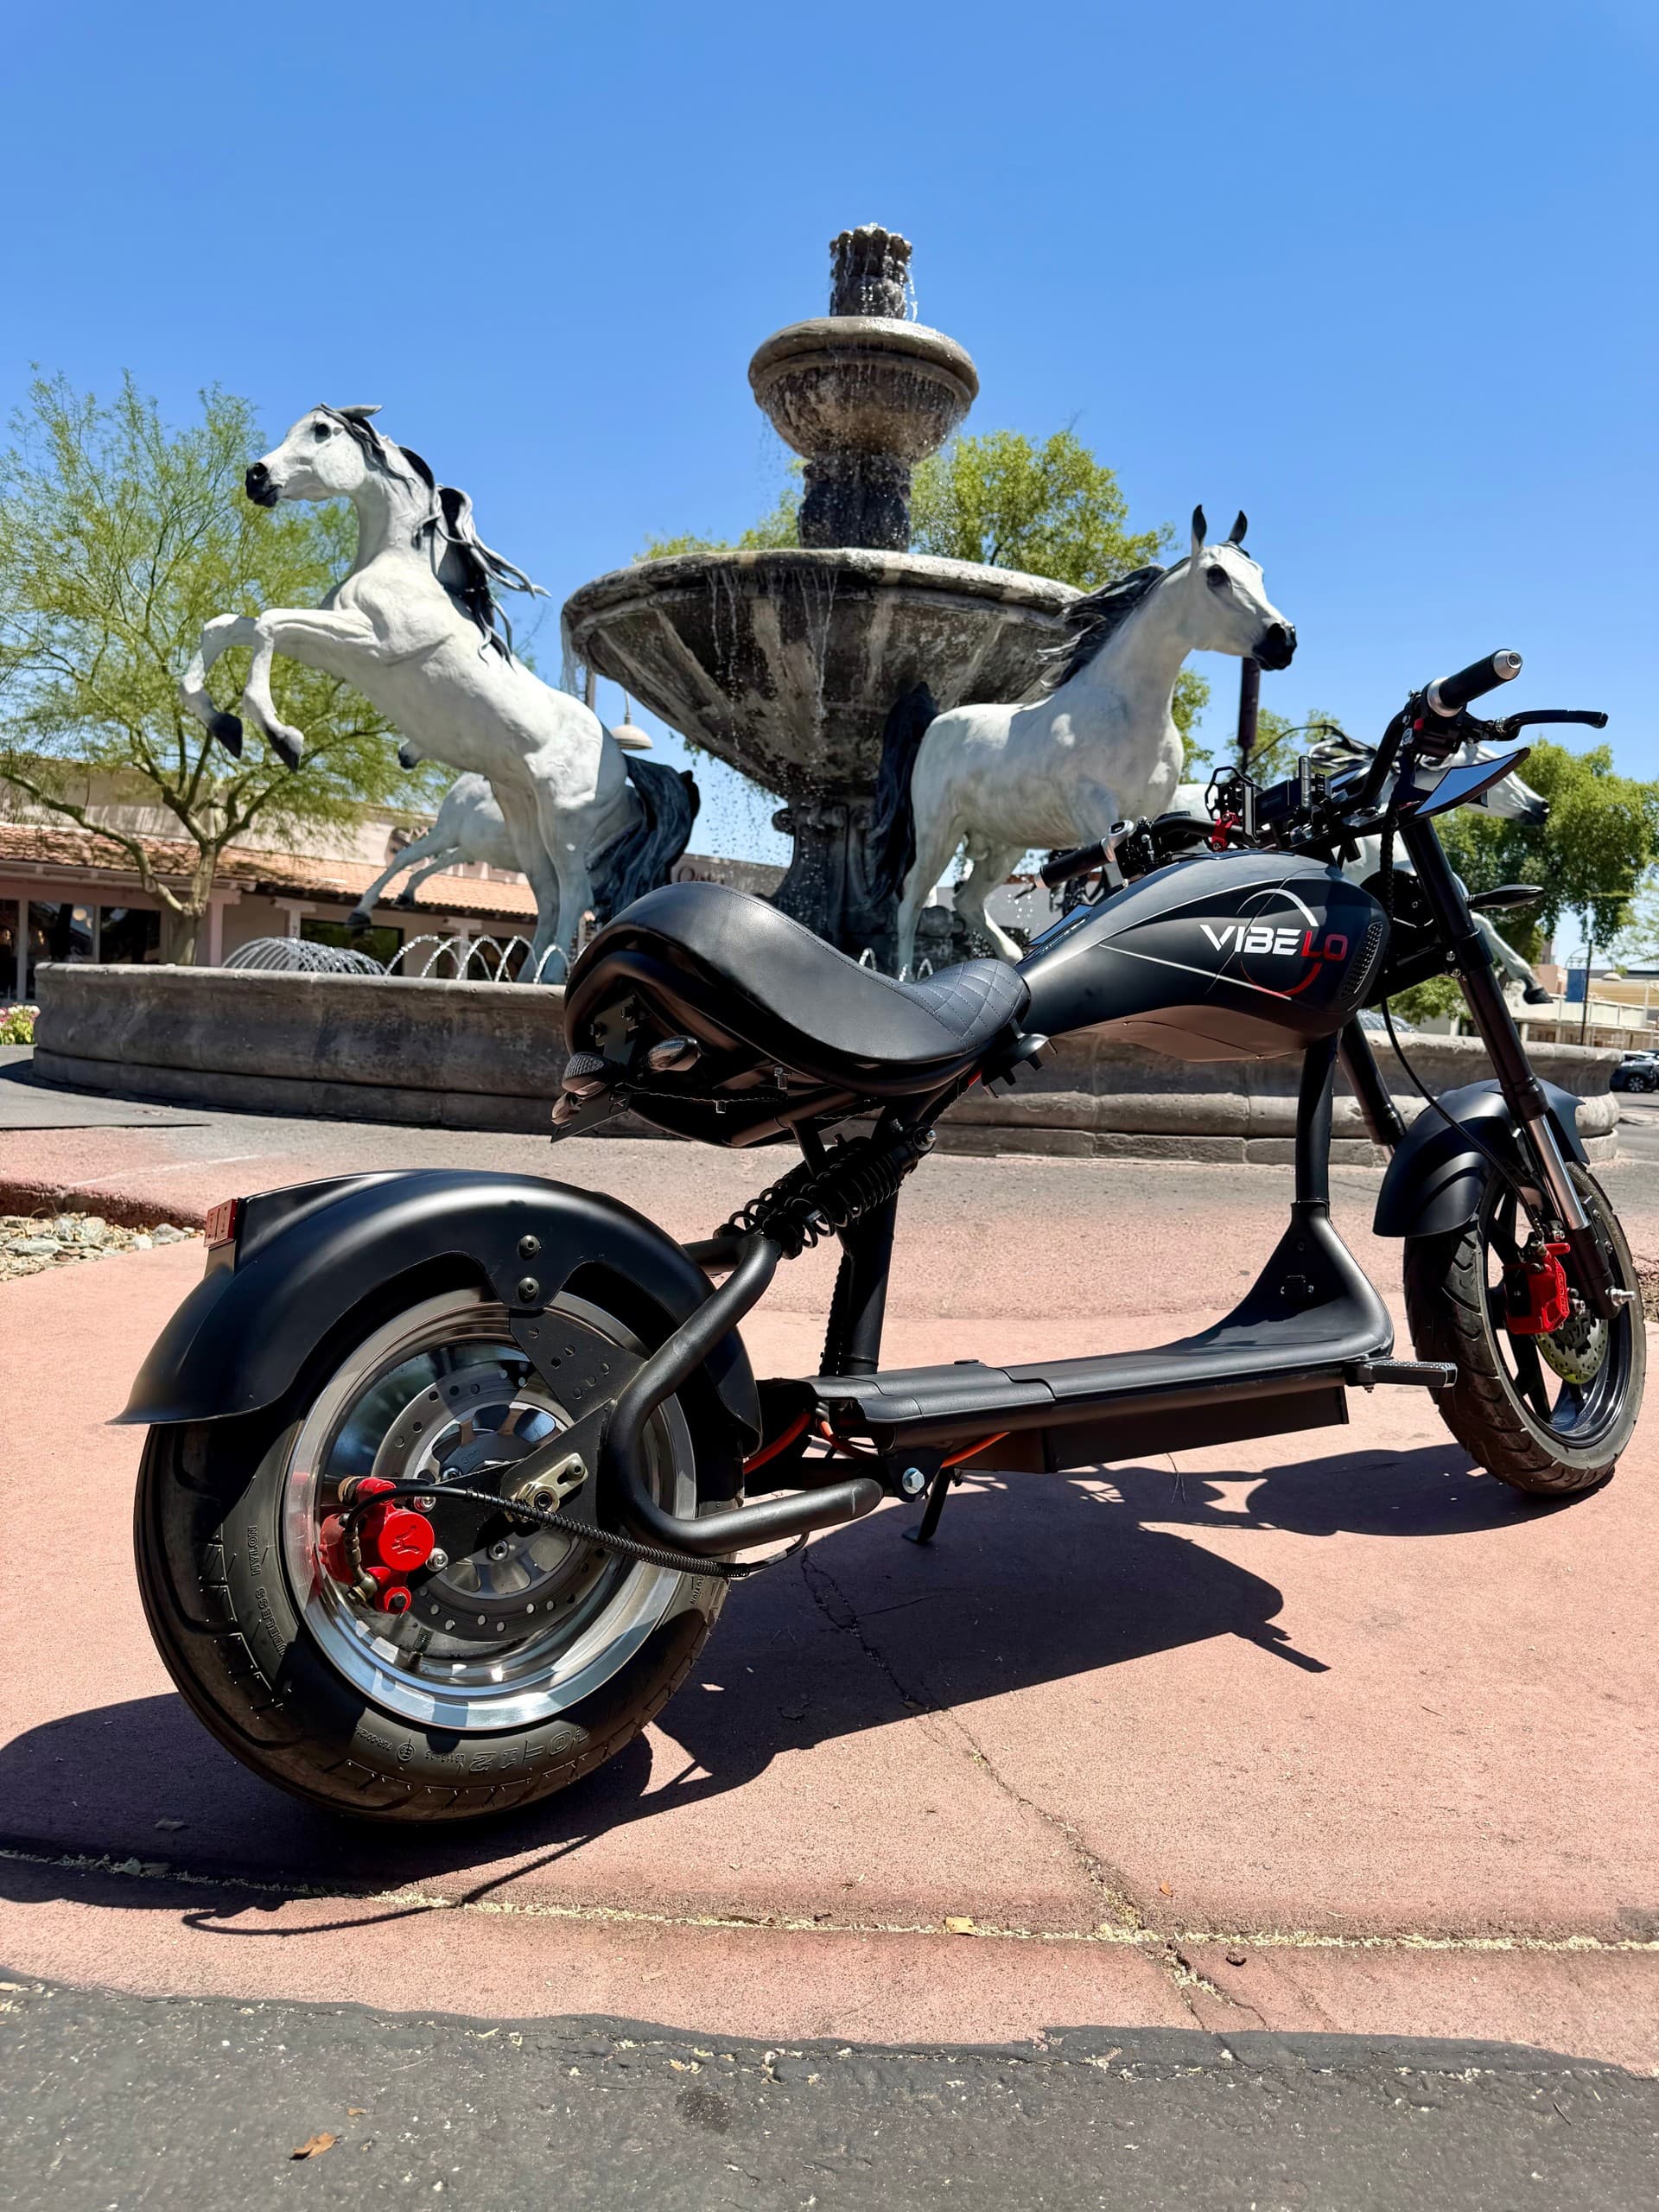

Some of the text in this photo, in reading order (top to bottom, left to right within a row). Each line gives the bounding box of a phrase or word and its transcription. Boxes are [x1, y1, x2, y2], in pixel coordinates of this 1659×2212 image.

[1199, 925, 1348, 961] VIBELO
[247, 1525, 287, 1658] UBELESS NYLON
